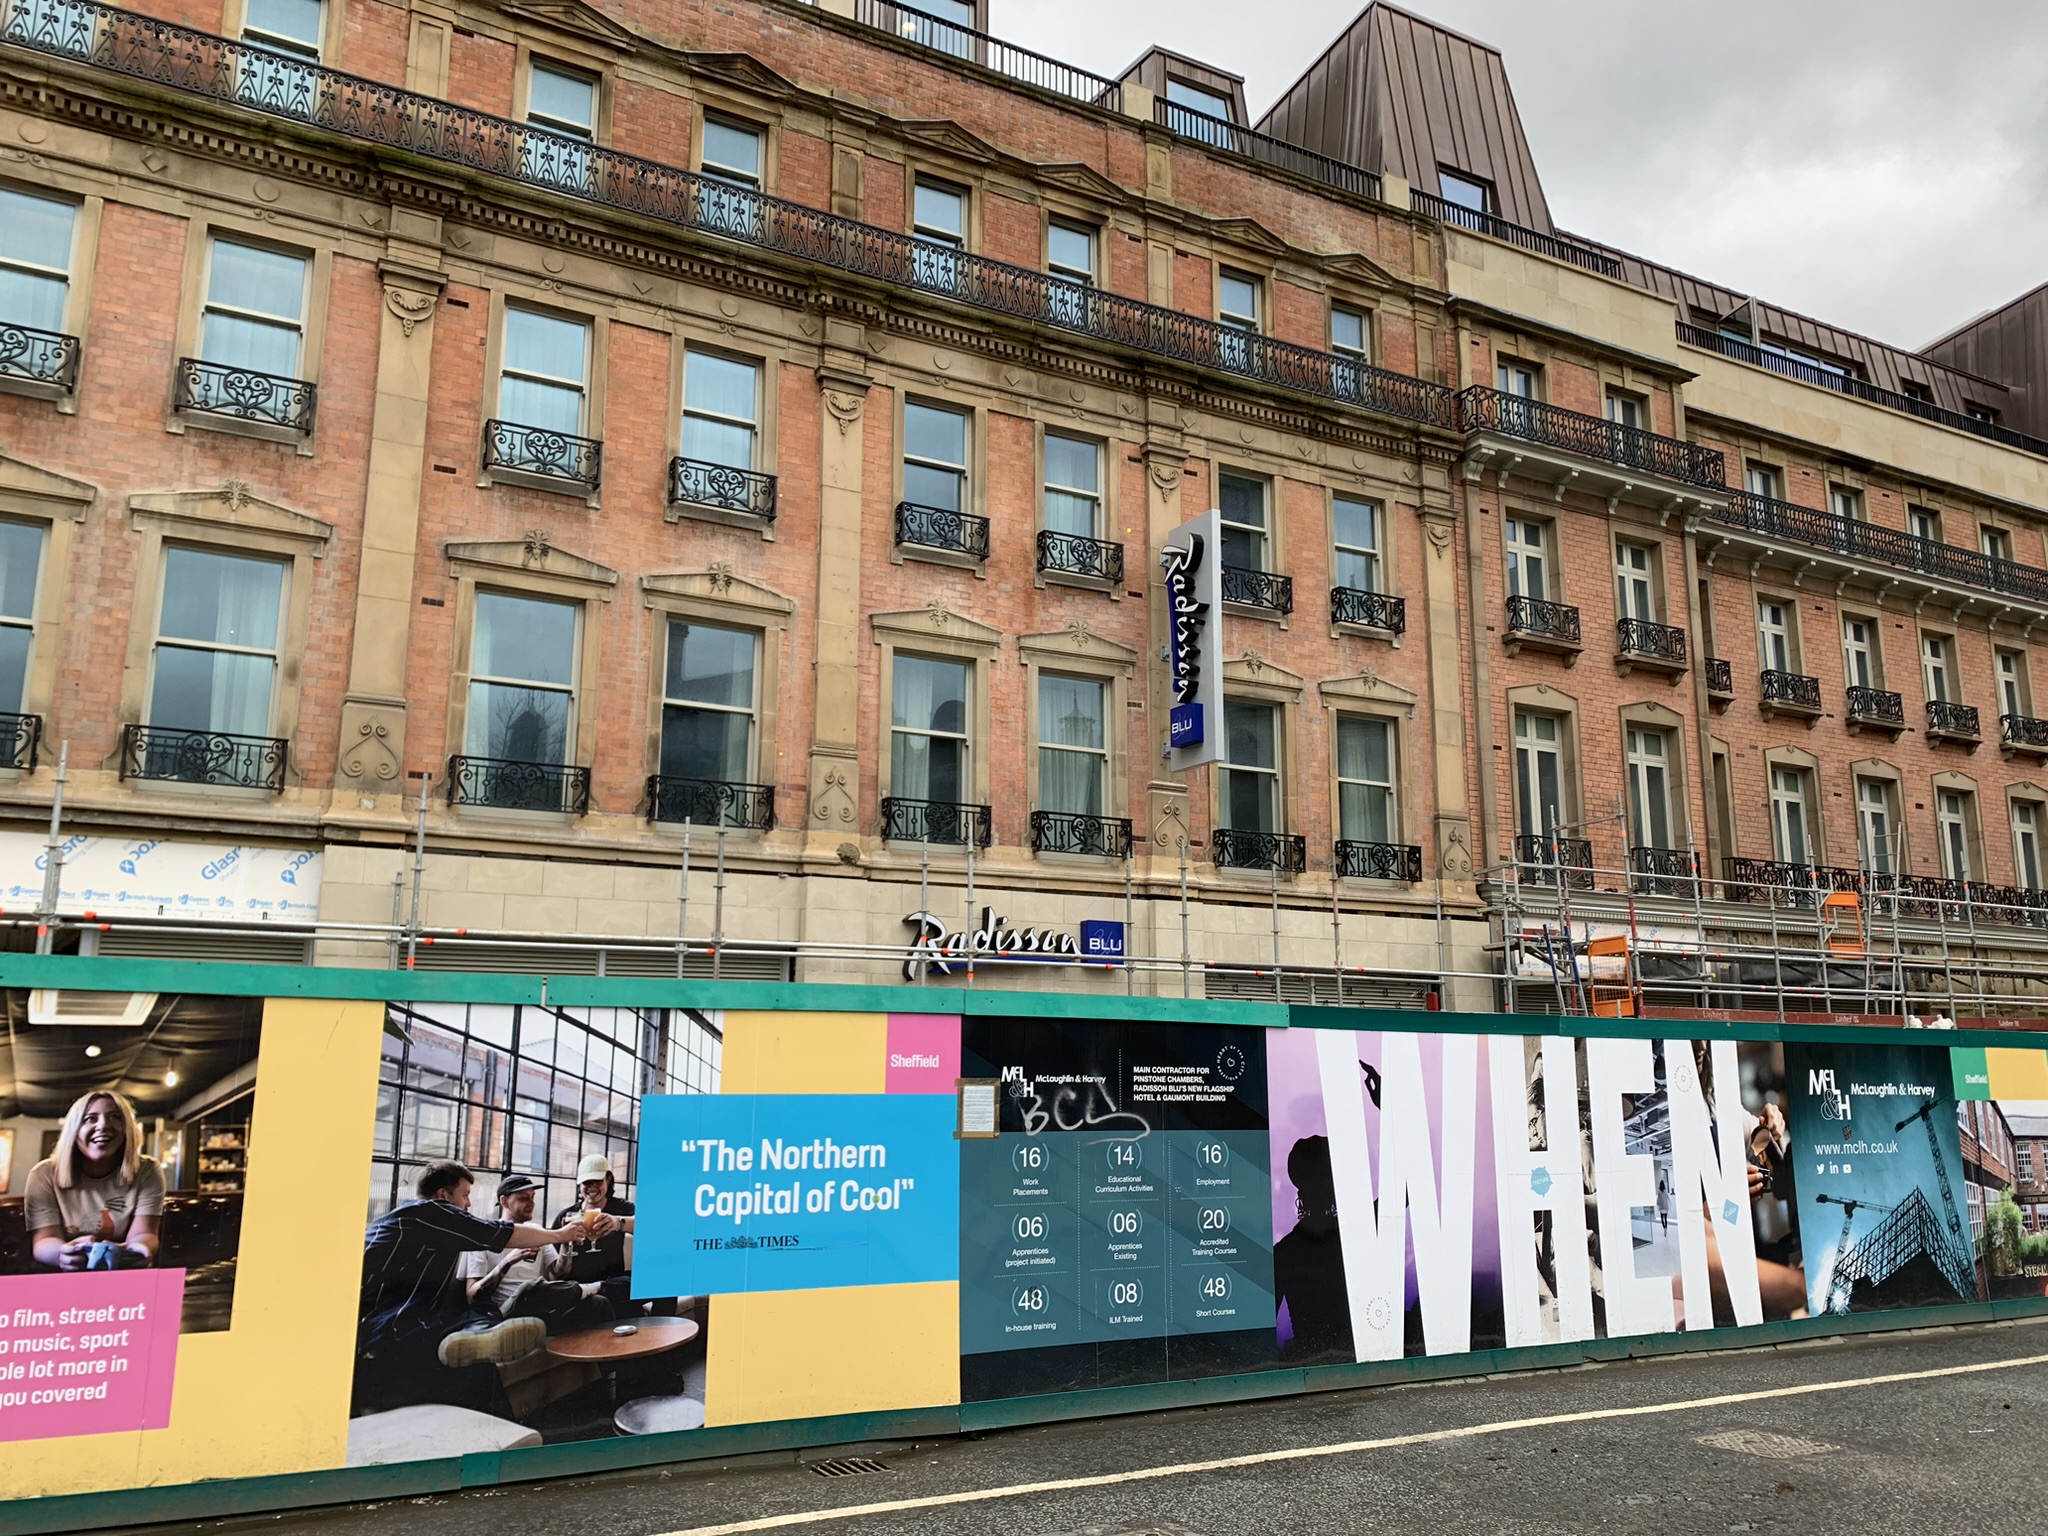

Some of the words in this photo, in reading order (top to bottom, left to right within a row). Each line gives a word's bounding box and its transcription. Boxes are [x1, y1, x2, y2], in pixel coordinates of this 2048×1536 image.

[1161, 533, 1207, 703] Radisson
[1171, 721, 1192, 734] BLU
[902, 906, 1081, 981] Radisson
[1089, 937, 1122, 951] BLU
[890, 1053, 940, 1069] Sheffield
[1133, 1066, 1150, 1074] MAIN
[1151, 1066, 1196, 1075] CONTRACTOR
[1196, 1067, 1210, 1075] FOR
[1035, 1074, 1074, 1084] McLaughlin
[1075, 1075, 1081, 1083] &
[1082, 1075, 1106, 1084] Harvey
[1133, 1075, 1166, 1083] PINSTONE
[1167, 1076, 1205, 1085] CHAMBERS,
[1964, 1074, 1988, 1084] Sheffield
[1133, 1084, 1167, 1092] RADISSON
[1203, 1085, 1235, 1093] FLAGSHIP
[1850, 1082, 1898, 1098] McLaughlin
[1899, 1083, 1907, 1096] &
[1907, 1084, 1936, 1098] Harvey
[1162, 1094, 1195, 1102] GAUMONT
[1195, 1094, 1226, 1102] BUILDING
[1814, 1140, 1899, 1155] www.mclh.co.uk
[760, 1137, 886, 1170] Northern
[1022, 1178, 1039, 1186] Work
[1107, 1175, 1141, 1183] Educational
[1196, 1178, 1230, 1187] Employment
[1012, 1188, 1049, 1196] Placements
[1095, 1185, 1128, 1193] Curriculum
[1128, 1184, 1154, 1192] Activities
[1315, 1028, 1764, 1363] WHEN
[694, 1182, 800, 1225] Capital
[806, 1180, 836, 1213] of
[693, 1238, 723, 1251] THE
[758, 1235, 800, 1249] TIMES
[1107, 1242, 1143, 1251] Apprentices
[1199, 1238, 1229, 1246] Accredited
[1012, 1247, 1049, 1257] Apprentices
[1113, 1252, 1137, 1261] Existing
[1191, 1247, 1213, 1256] Training
[1213, 1247, 1237, 1255] Courses
[1005, 1259, 1029, 1268] (project
[1029, 1256, 1056, 1266] initiated)
[13, 1309, 55, 1328] film,
[58, 1305, 115, 1325] street
[118, 1303, 146, 1321] art
[1196, 1309, 1211, 1318] Short
[1212, 1308, 1236, 1316] Courses
[1109, 1316, 1121, 1324] ILM
[1122, 1315, 1143, 1323] Trained
[1005, 1323, 1032, 1333] In-house
[1033, 1322, 1057, 1331] training
[13, 1333, 76, 1354] music,
[79, 1329, 130, 1353] sport
[28, 1360, 54, 1379] lot
[58, 1361, 107, 1377] more
[110, 1355, 128, 1373] in
[31, 1381, 108, 1405] covered
